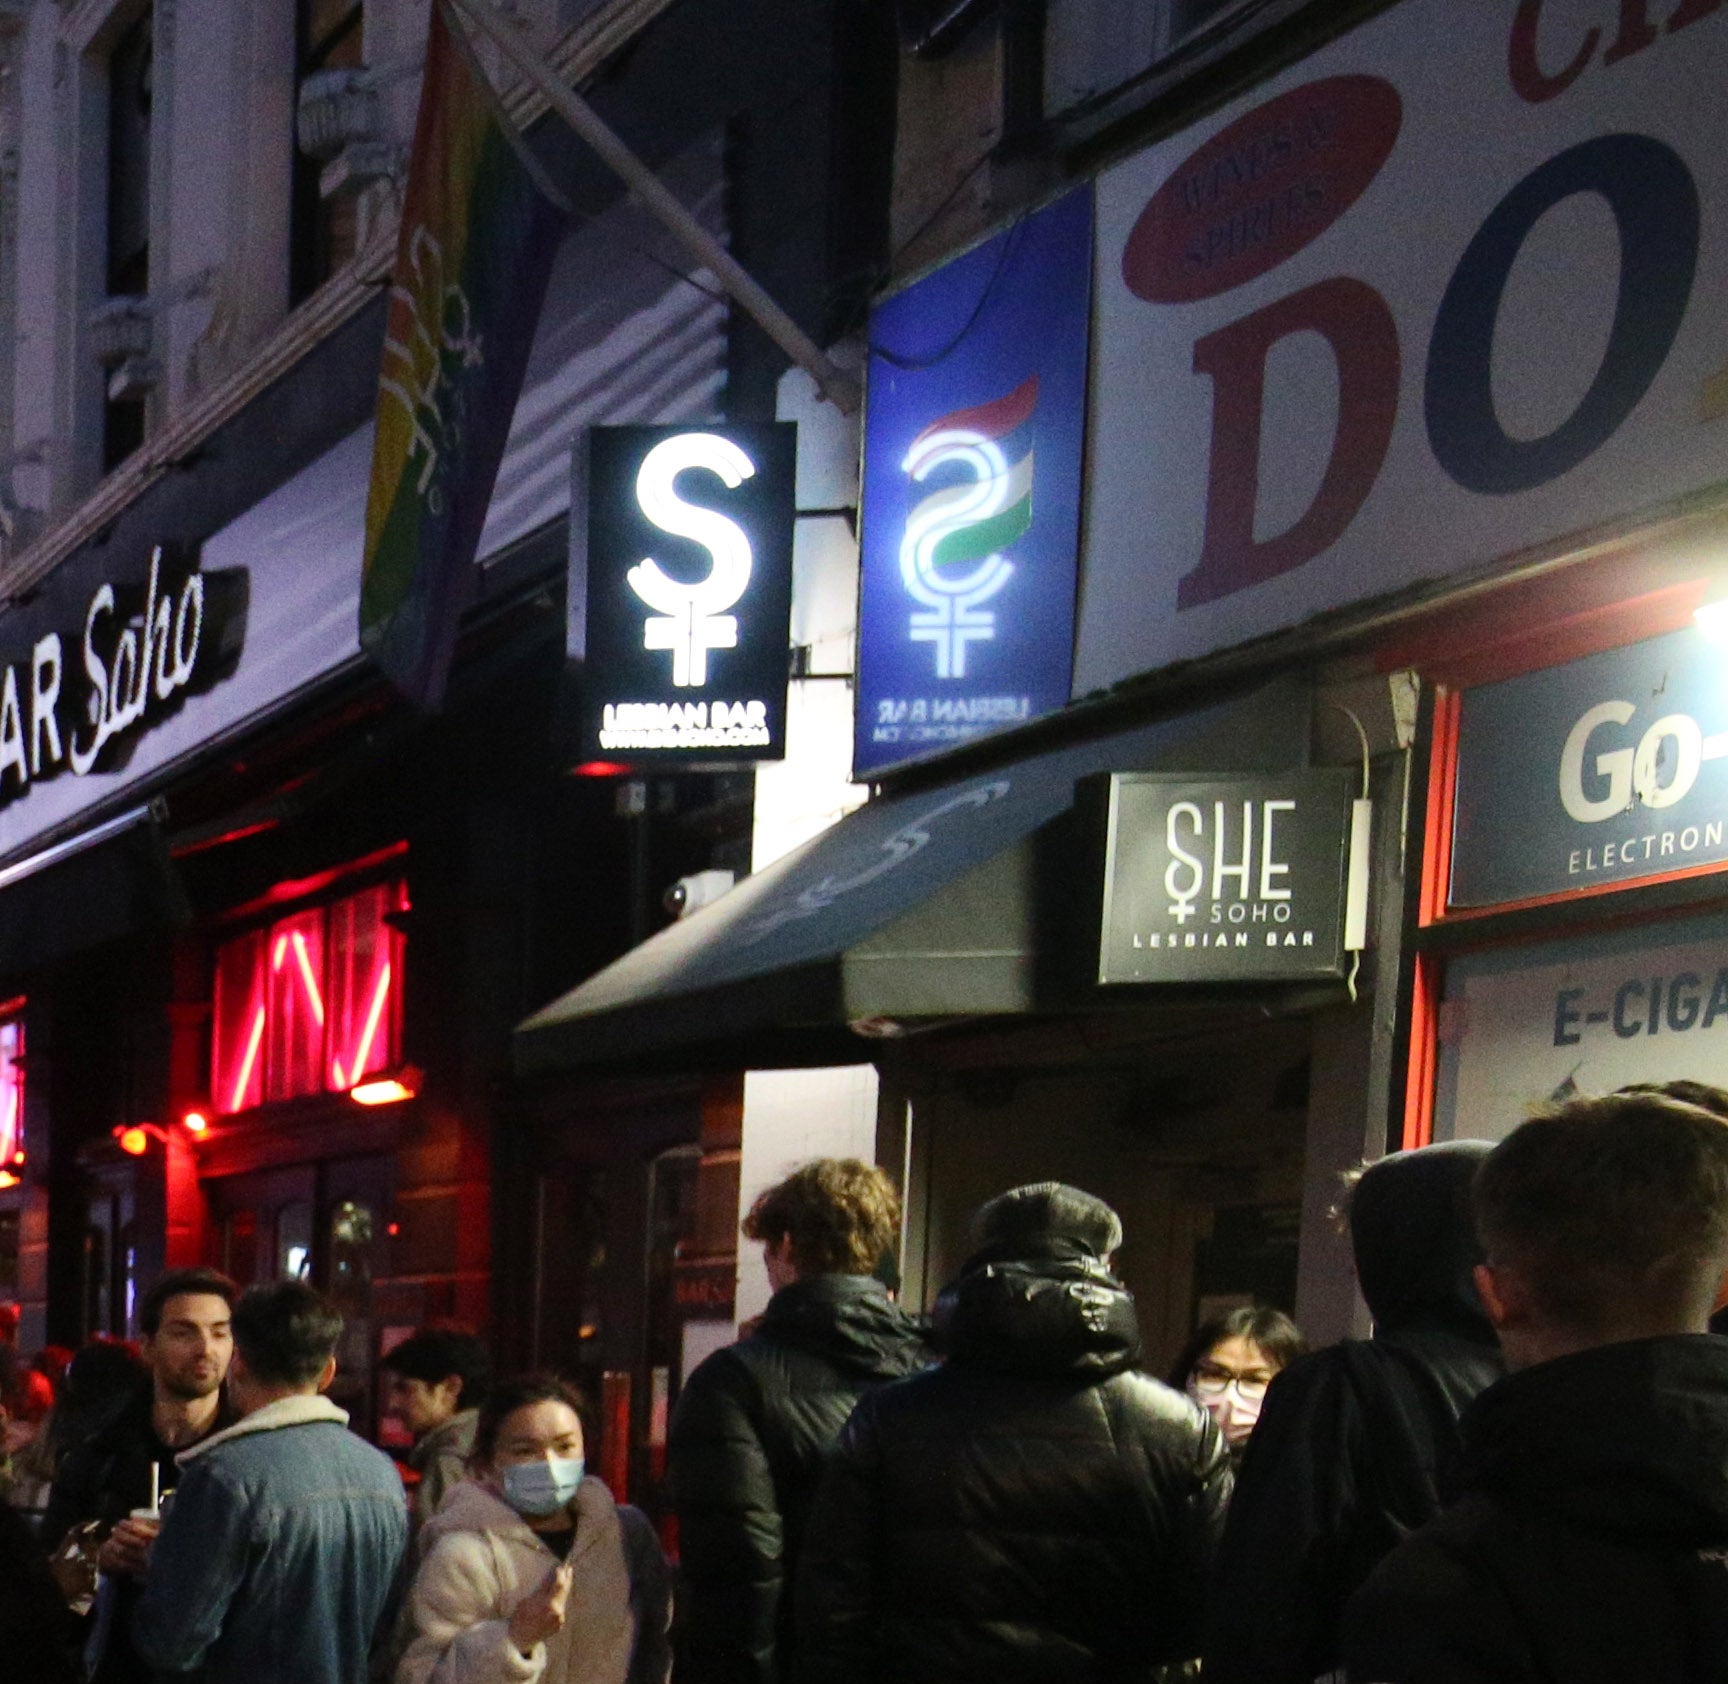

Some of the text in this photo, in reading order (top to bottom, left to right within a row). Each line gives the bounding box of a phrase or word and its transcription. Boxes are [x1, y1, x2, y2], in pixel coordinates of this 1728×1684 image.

[1177, 132, 1728, 612] DO
[72, 546, 205, 775] Soho
[1164, 800, 1296, 902] SHE
[1569, 821, 1722, 874] ELECTRON
[1133, 931, 1313, 949] LESBIAN BAR
[1210, 903, 1291, 923] SOHO
[1553, 967, 1728, 1048] E-CIGA
